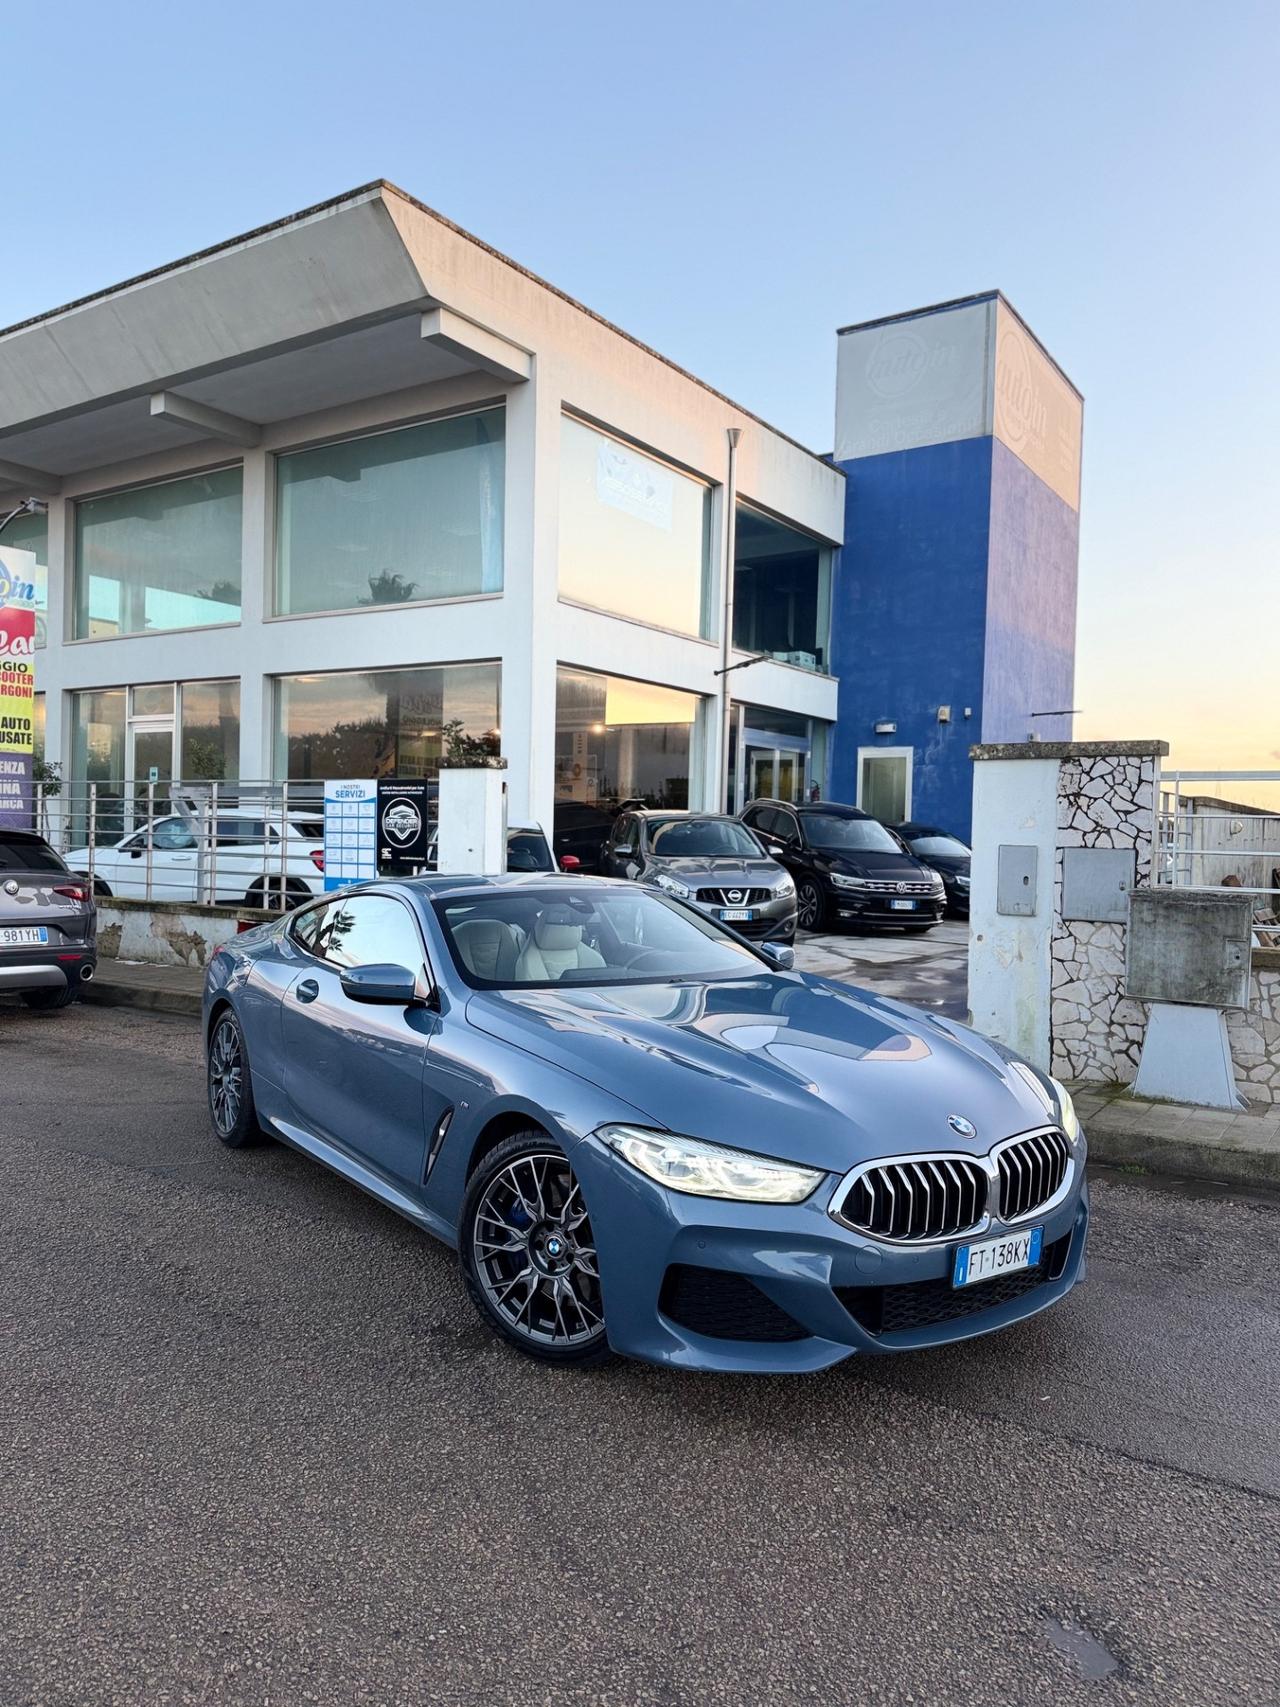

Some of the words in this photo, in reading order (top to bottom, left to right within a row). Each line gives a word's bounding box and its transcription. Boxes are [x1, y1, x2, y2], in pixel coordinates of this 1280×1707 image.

[0, 661, 28, 673] GIO
[0, 671, 33, 686] OOTER
[1, 716, 31, 731] AUTO
[335, 790, 366, 798] SERVIZI
[4, 929, 39, 941] 981YH
